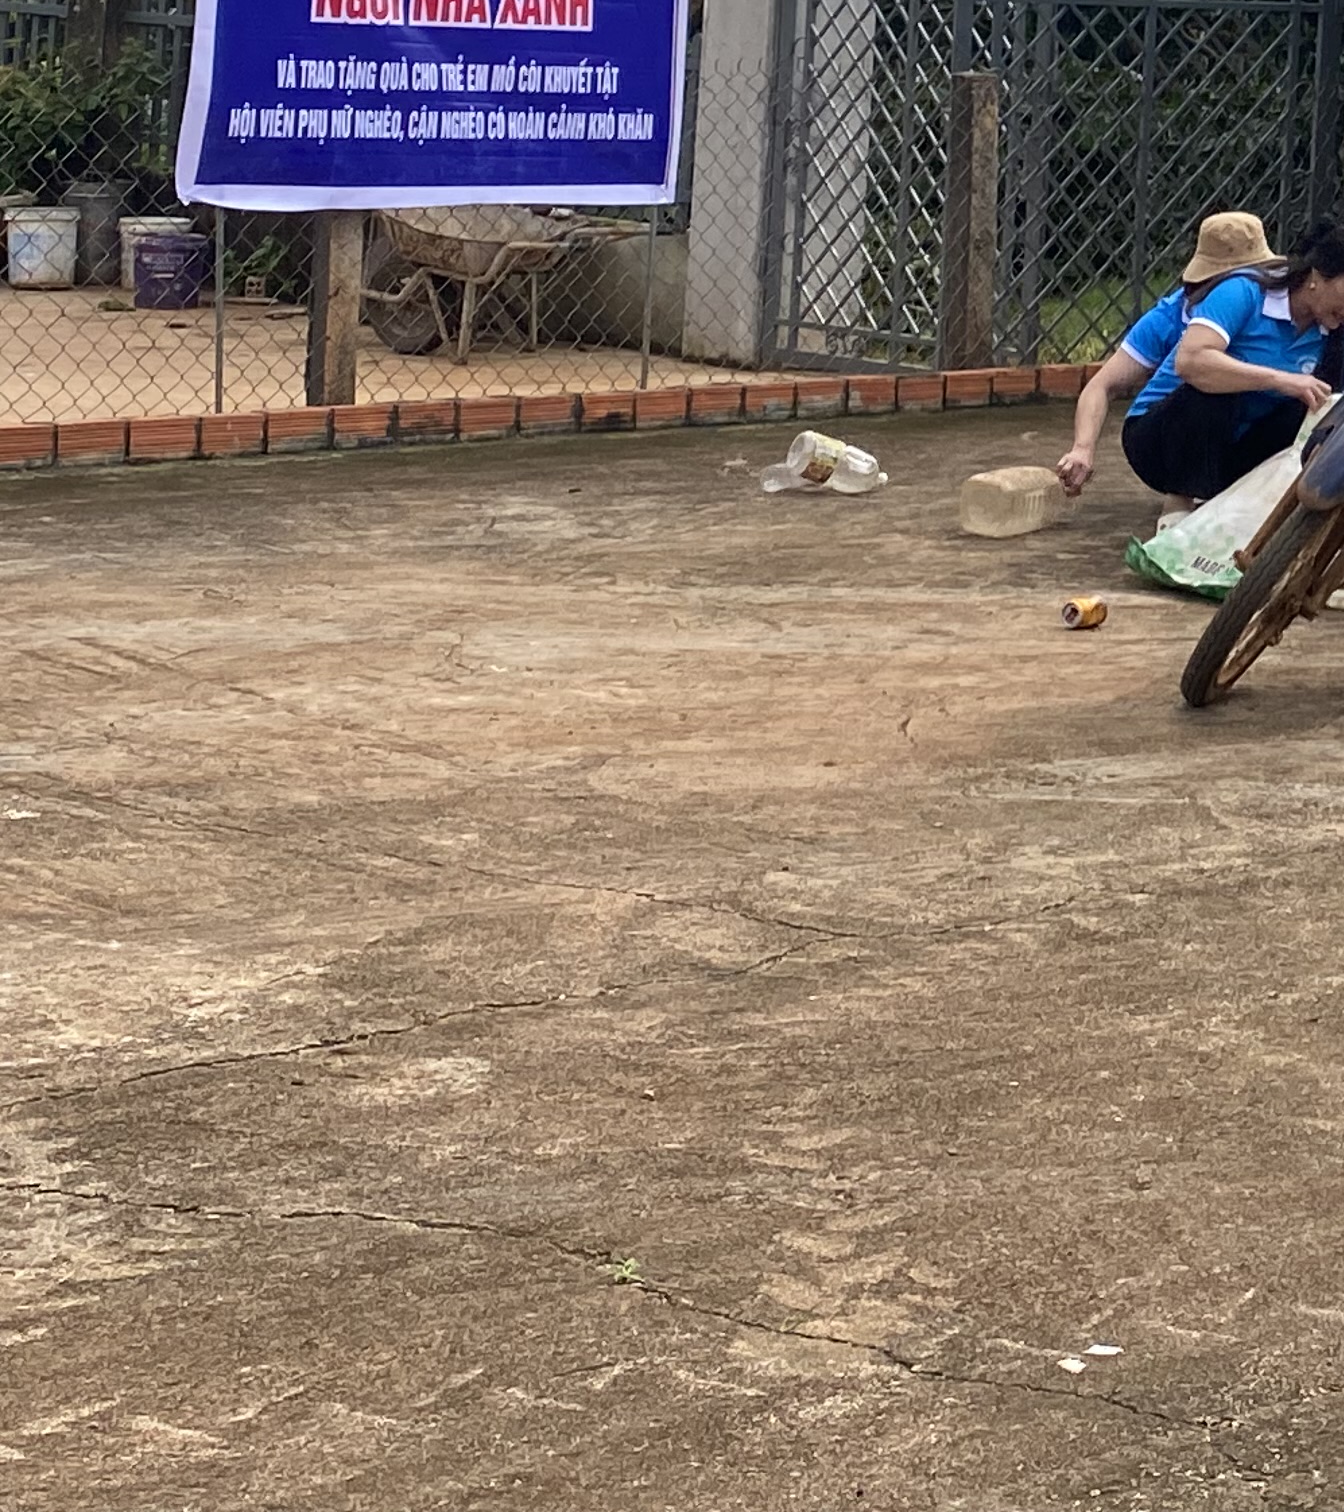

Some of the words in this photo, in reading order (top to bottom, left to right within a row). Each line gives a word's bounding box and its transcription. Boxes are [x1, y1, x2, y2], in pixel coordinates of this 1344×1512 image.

[277, 53, 296, 88] VÀ
[300, 59, 335, 89] TRAO
[338, 54, 377, 96] TẶNG
[379, 56, 409, 94] QUÀ
[412, 61, 439, 91] CHO
[440, 54, 464, 92] TRẺ
[467, 64, 489, 92] EM
[518, 59, 542, 93] CÔI
[543, 57, 594, 94] KHUYẾT
[595, 60, 620, 101] TẬT
[228, 101, 257, 144] HỘI
[259, 102, 295, 138] VIÊN
[297, 108, 329, 145] PHỤ
[330, 104, 354, 138] NỮ
[354, 104, 404, 143] NGHÈO,
[408, 104, 439, 146] CẬN
[440, 104, 485, 139] NGHÈO
[487, 105, 506, 139] CÓ
[507, 105, 545, 140] HOÀN
[547, 103, 586, 140] CẢNH
[587, 106, 615, 141] KHÓ
[617, 107, 654, 141] KHĂN
